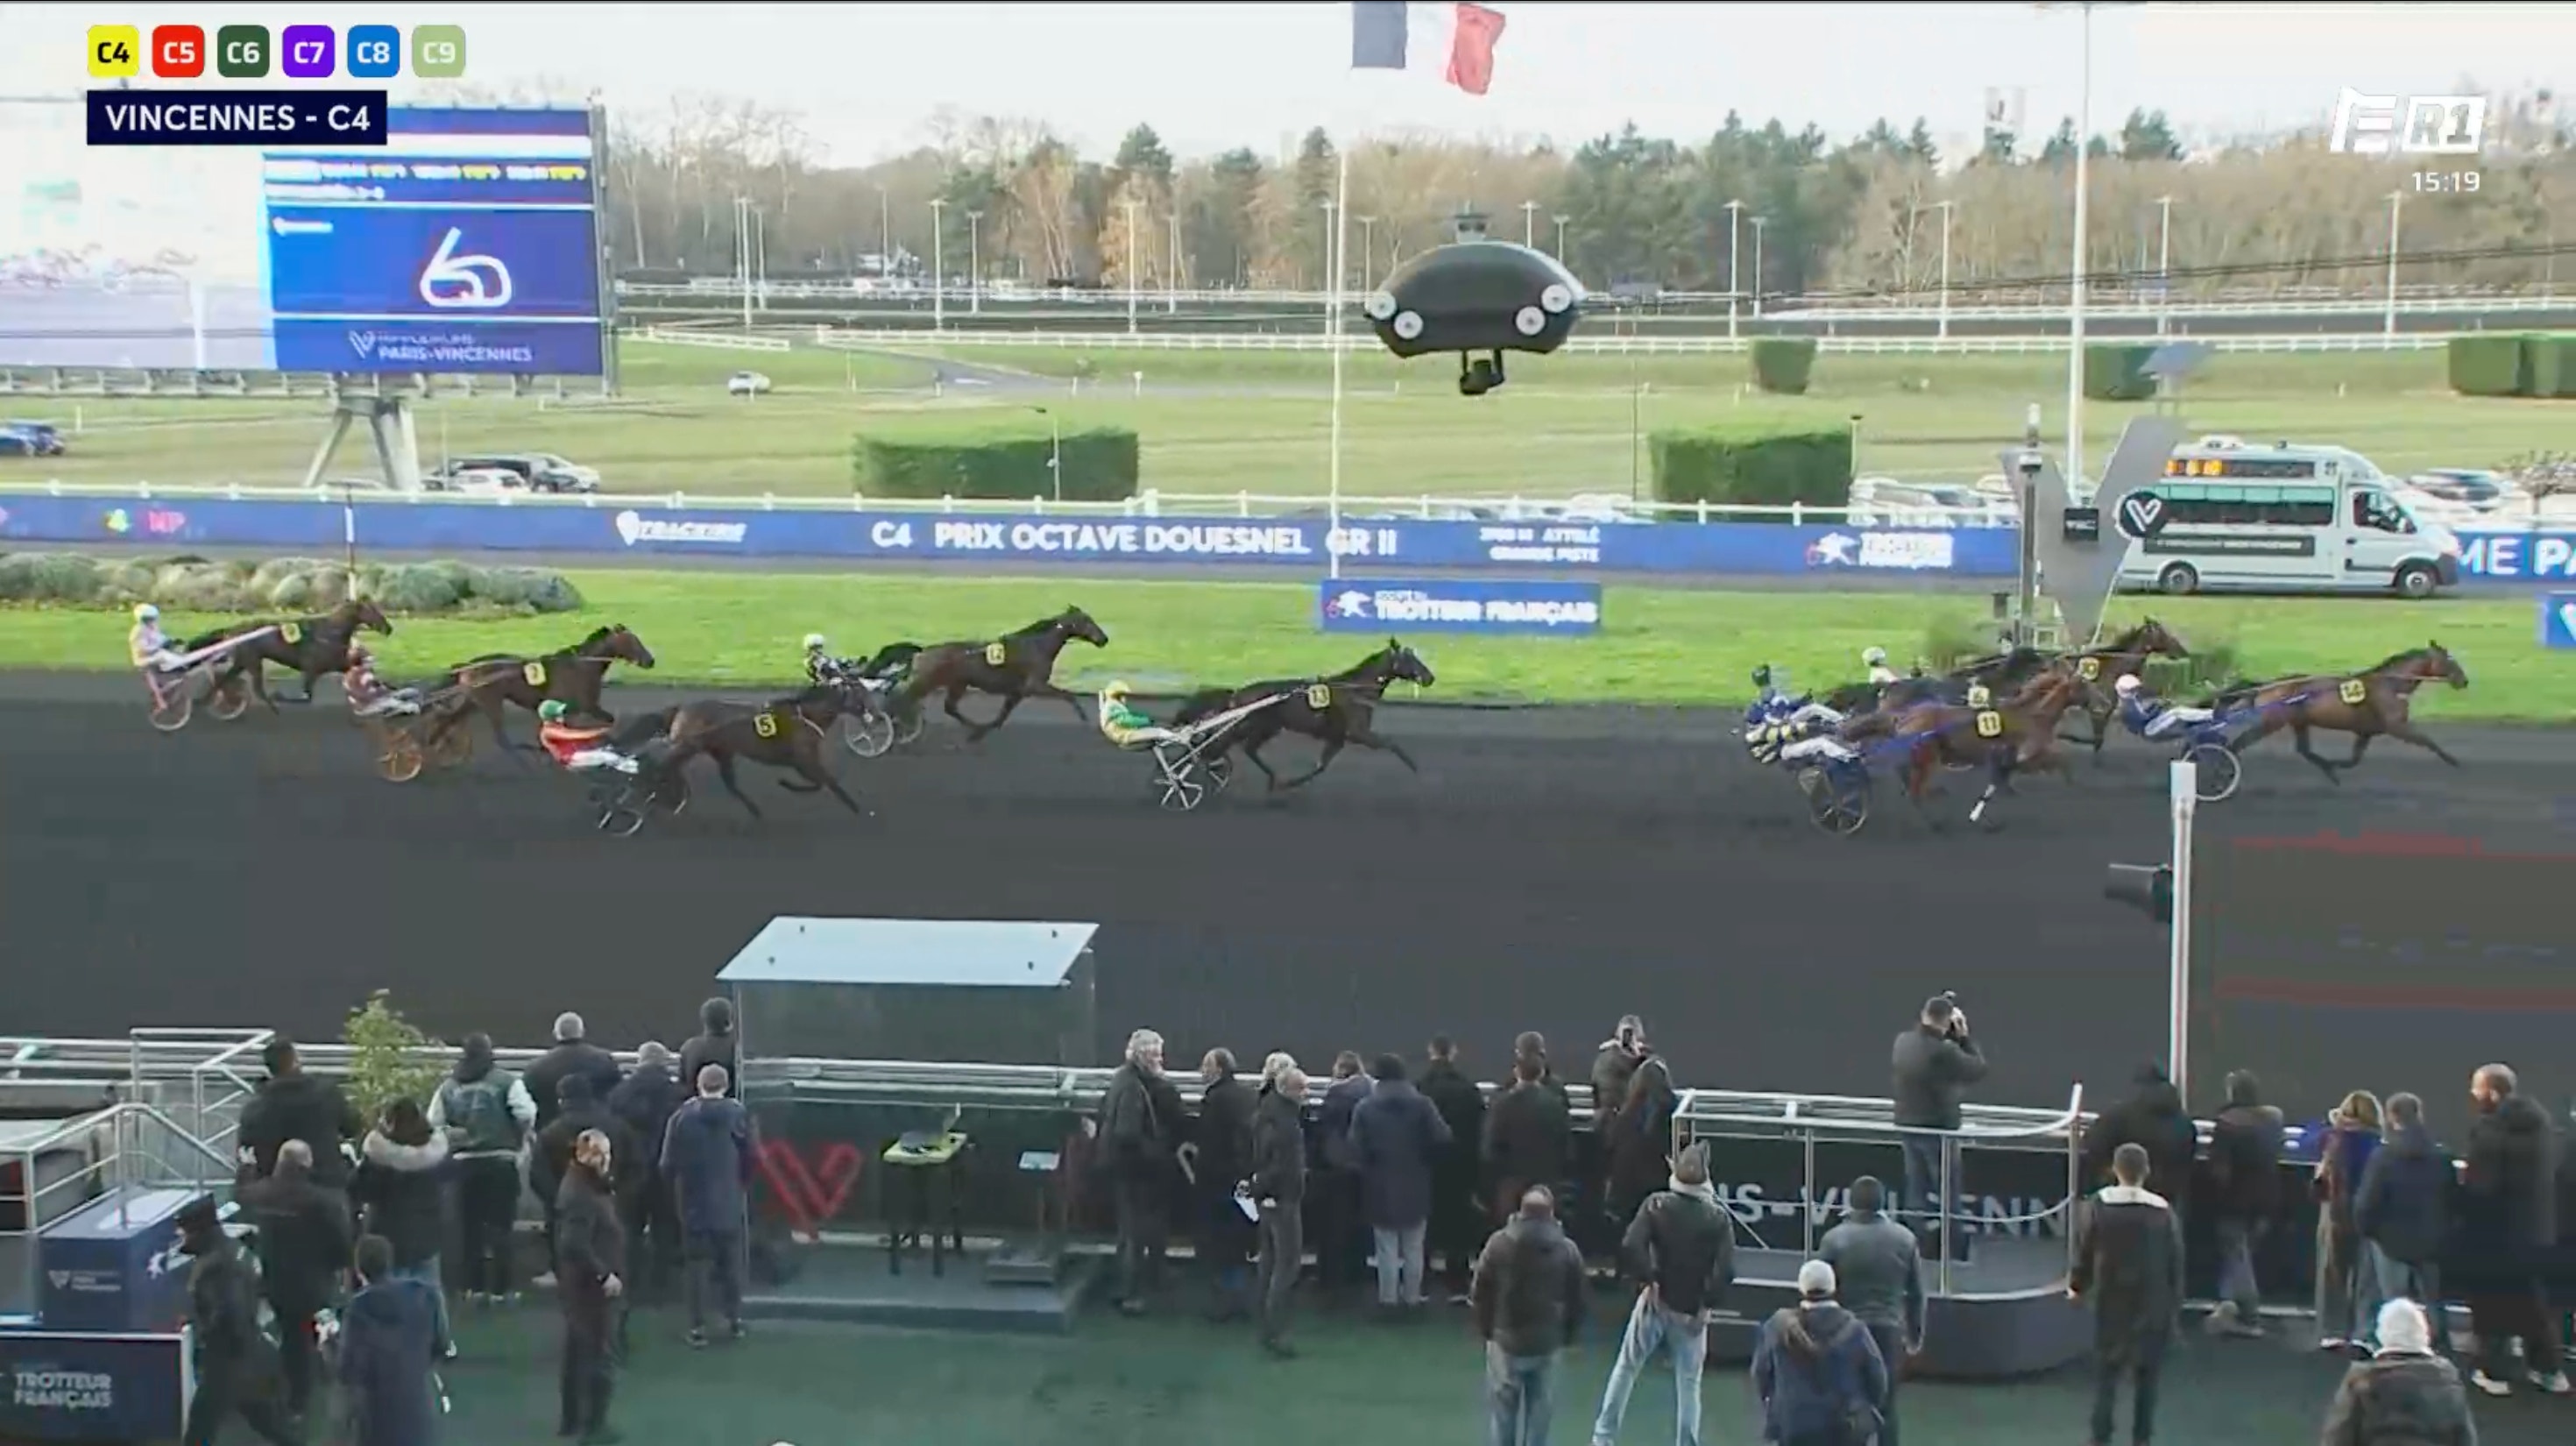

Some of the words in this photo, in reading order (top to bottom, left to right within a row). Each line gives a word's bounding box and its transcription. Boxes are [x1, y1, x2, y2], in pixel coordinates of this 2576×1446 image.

[378, 345, 533, 363] PARIS-VINCENNES
[871, 521, 913, 548] C4
[934, 521, 1007, 550] PRIX
[1010, 522, 1139, 552] OCTAVE
[1143, 524, 1313, 555] DOUESNEL
[15, 1372, 112, 1391] TROTTEUR
